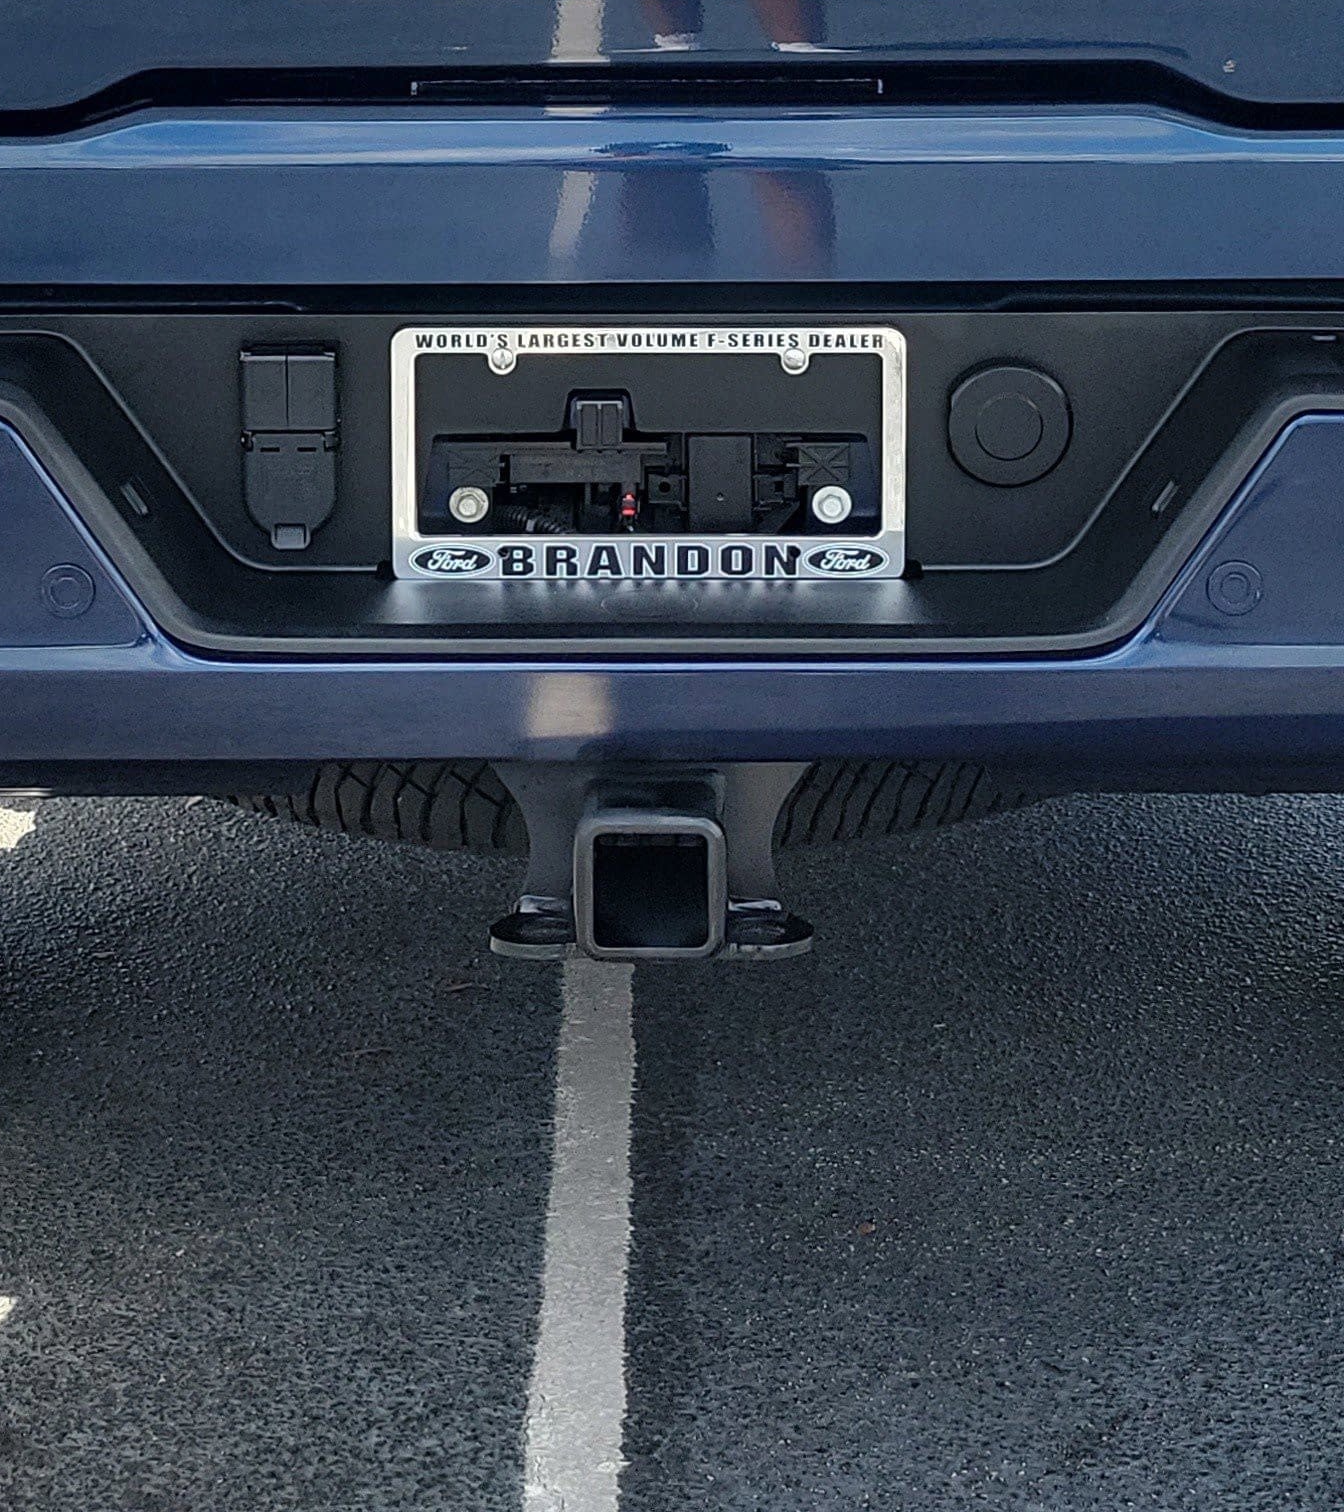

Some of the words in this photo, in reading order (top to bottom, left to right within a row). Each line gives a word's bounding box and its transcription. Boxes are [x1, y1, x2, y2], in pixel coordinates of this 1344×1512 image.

[415, 333, 509, 349] WORLD'S
[517, 333, 608, 349] LARGEST
[616, 333, 699, 348] VOLUME
[707, 333, 800, 348] F-SERIES
[808, 333, 884, 349] DEALER
[426, 548, 479, 571] Ford
[500, 543, 799, 577] BRANDON
[820, 548, 872, 571] Ford
